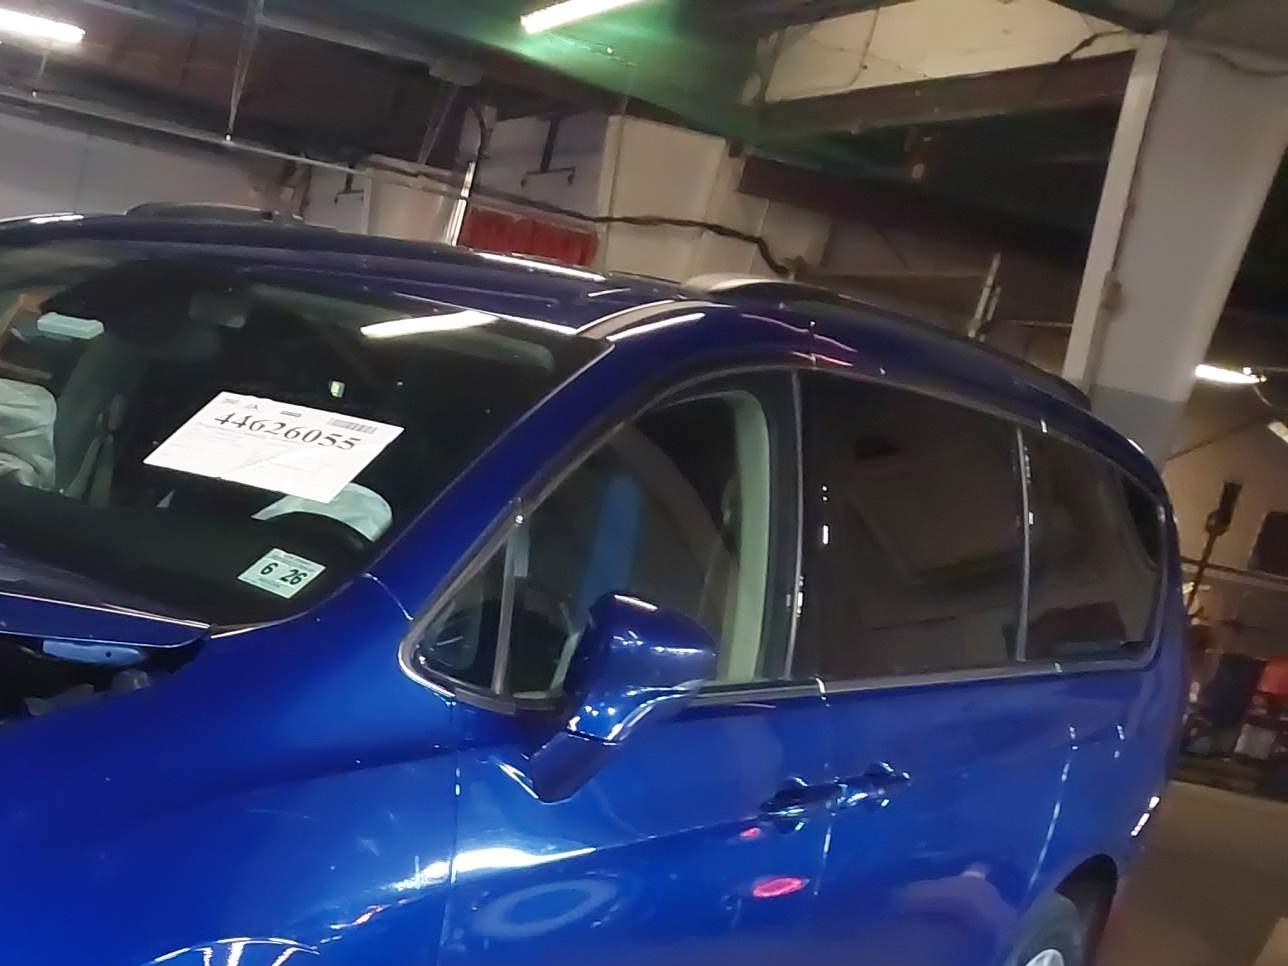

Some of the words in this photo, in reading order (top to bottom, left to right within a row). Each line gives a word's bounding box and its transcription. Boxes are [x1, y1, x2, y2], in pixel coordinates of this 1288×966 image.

[215, 413, 362, 450] 44626055
[260, 562, 278, 576] 6
[279, 568, 308, 586] 26
